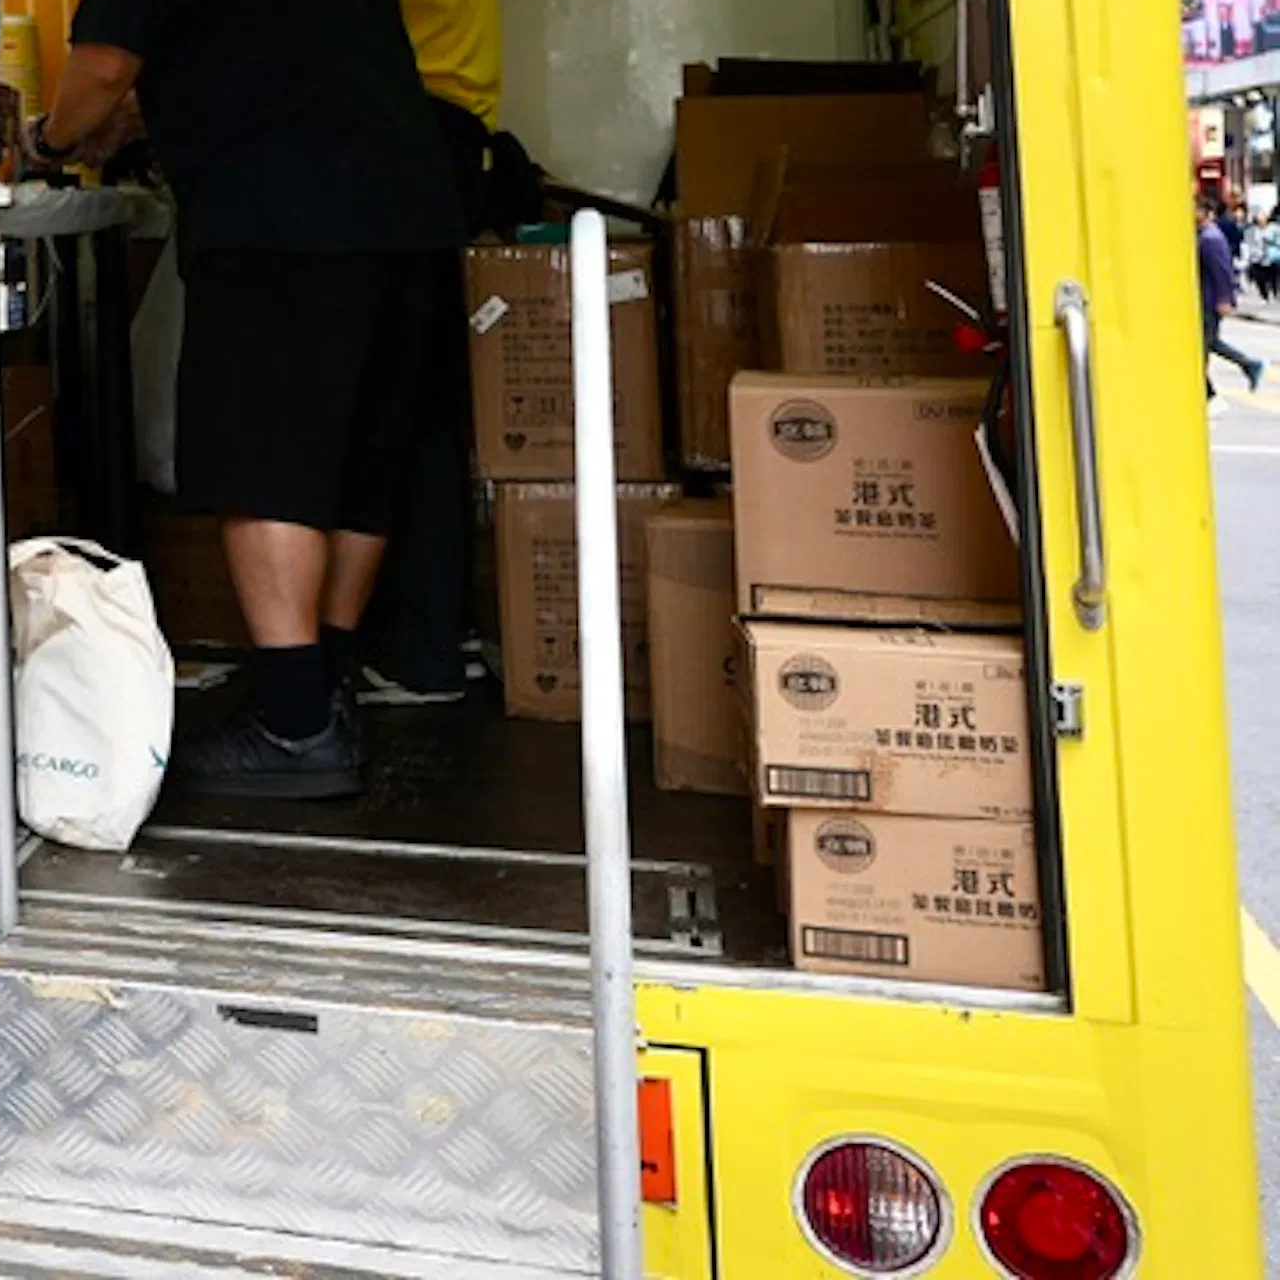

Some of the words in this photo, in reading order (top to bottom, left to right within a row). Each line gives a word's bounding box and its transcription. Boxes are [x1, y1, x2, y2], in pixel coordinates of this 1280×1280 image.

[852, 480, 915, 507] 港式
[914, 702, 977, 731] 港式
[952, 868, 1016, 897] 港式
